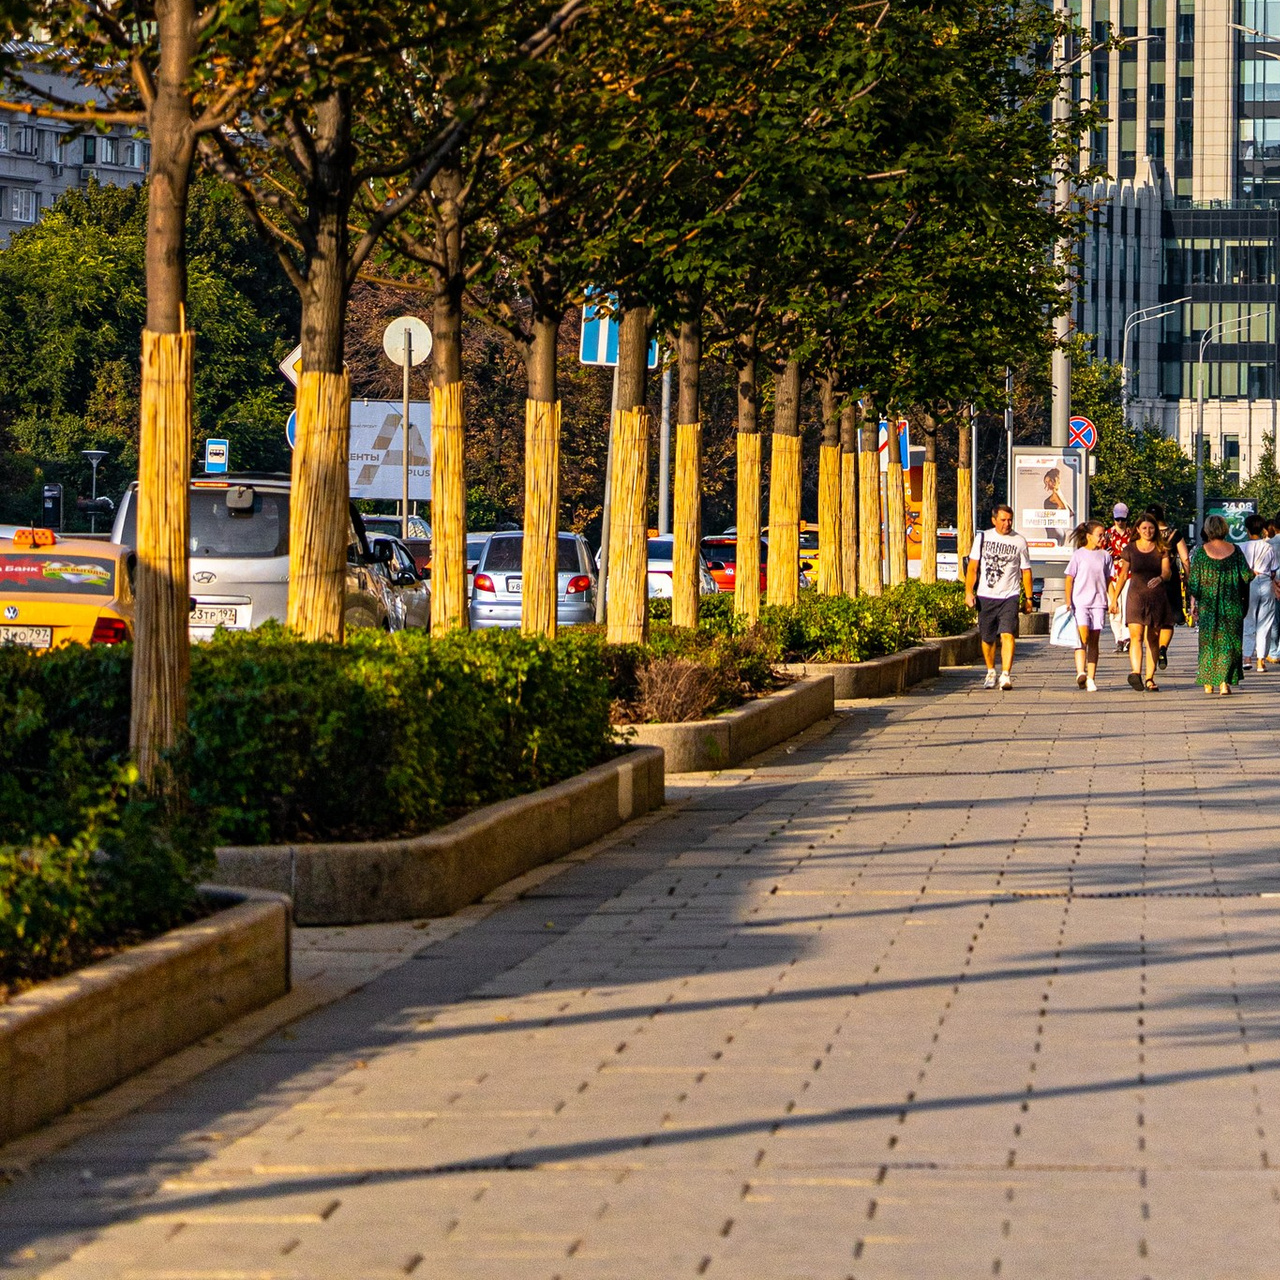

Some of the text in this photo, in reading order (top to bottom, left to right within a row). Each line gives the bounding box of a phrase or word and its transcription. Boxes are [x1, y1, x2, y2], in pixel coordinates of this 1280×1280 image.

[1222, 502, 1253, 510] 24.08
[218, 609, 233, 618] 197
[29, 628, 47, 639] 797
